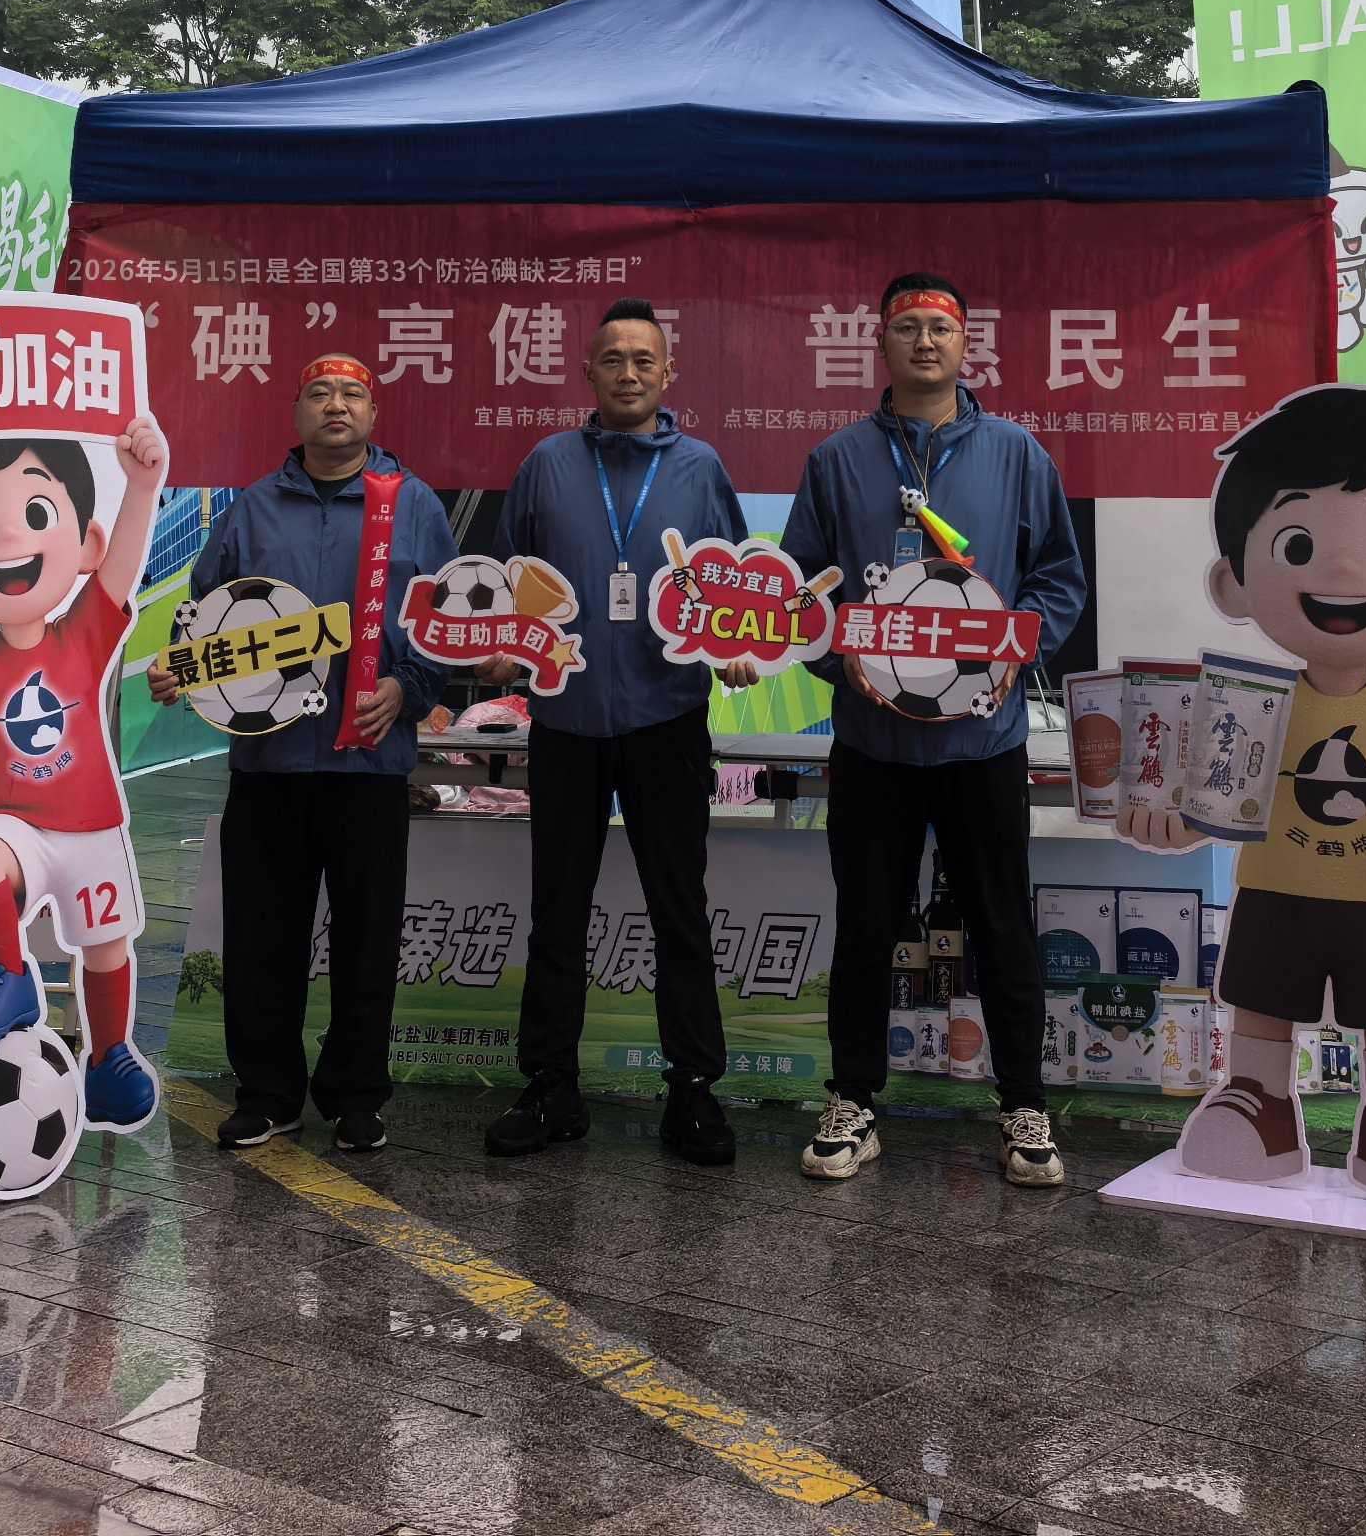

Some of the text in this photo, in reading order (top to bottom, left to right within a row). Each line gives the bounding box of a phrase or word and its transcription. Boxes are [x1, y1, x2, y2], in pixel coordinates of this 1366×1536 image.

[138, 300, 681, 387] “碘”亮健
[360, 540, 391, 641] 宜昌加油
[700, 561, 785, 597] 我为宜昌
[426, 617, 550, 651] E哥助威团
[676, 597, 810, 646] 打CALL
[841, 607, 1028, 659] 最佳十二人
[167, 612, 344, 689] 最佳十二人
[8, 750, 74, 779] 云鹤牌
[75, 880, 121, 929] 12
[389, 1024, 521, 1048] 北盐业集团有限
